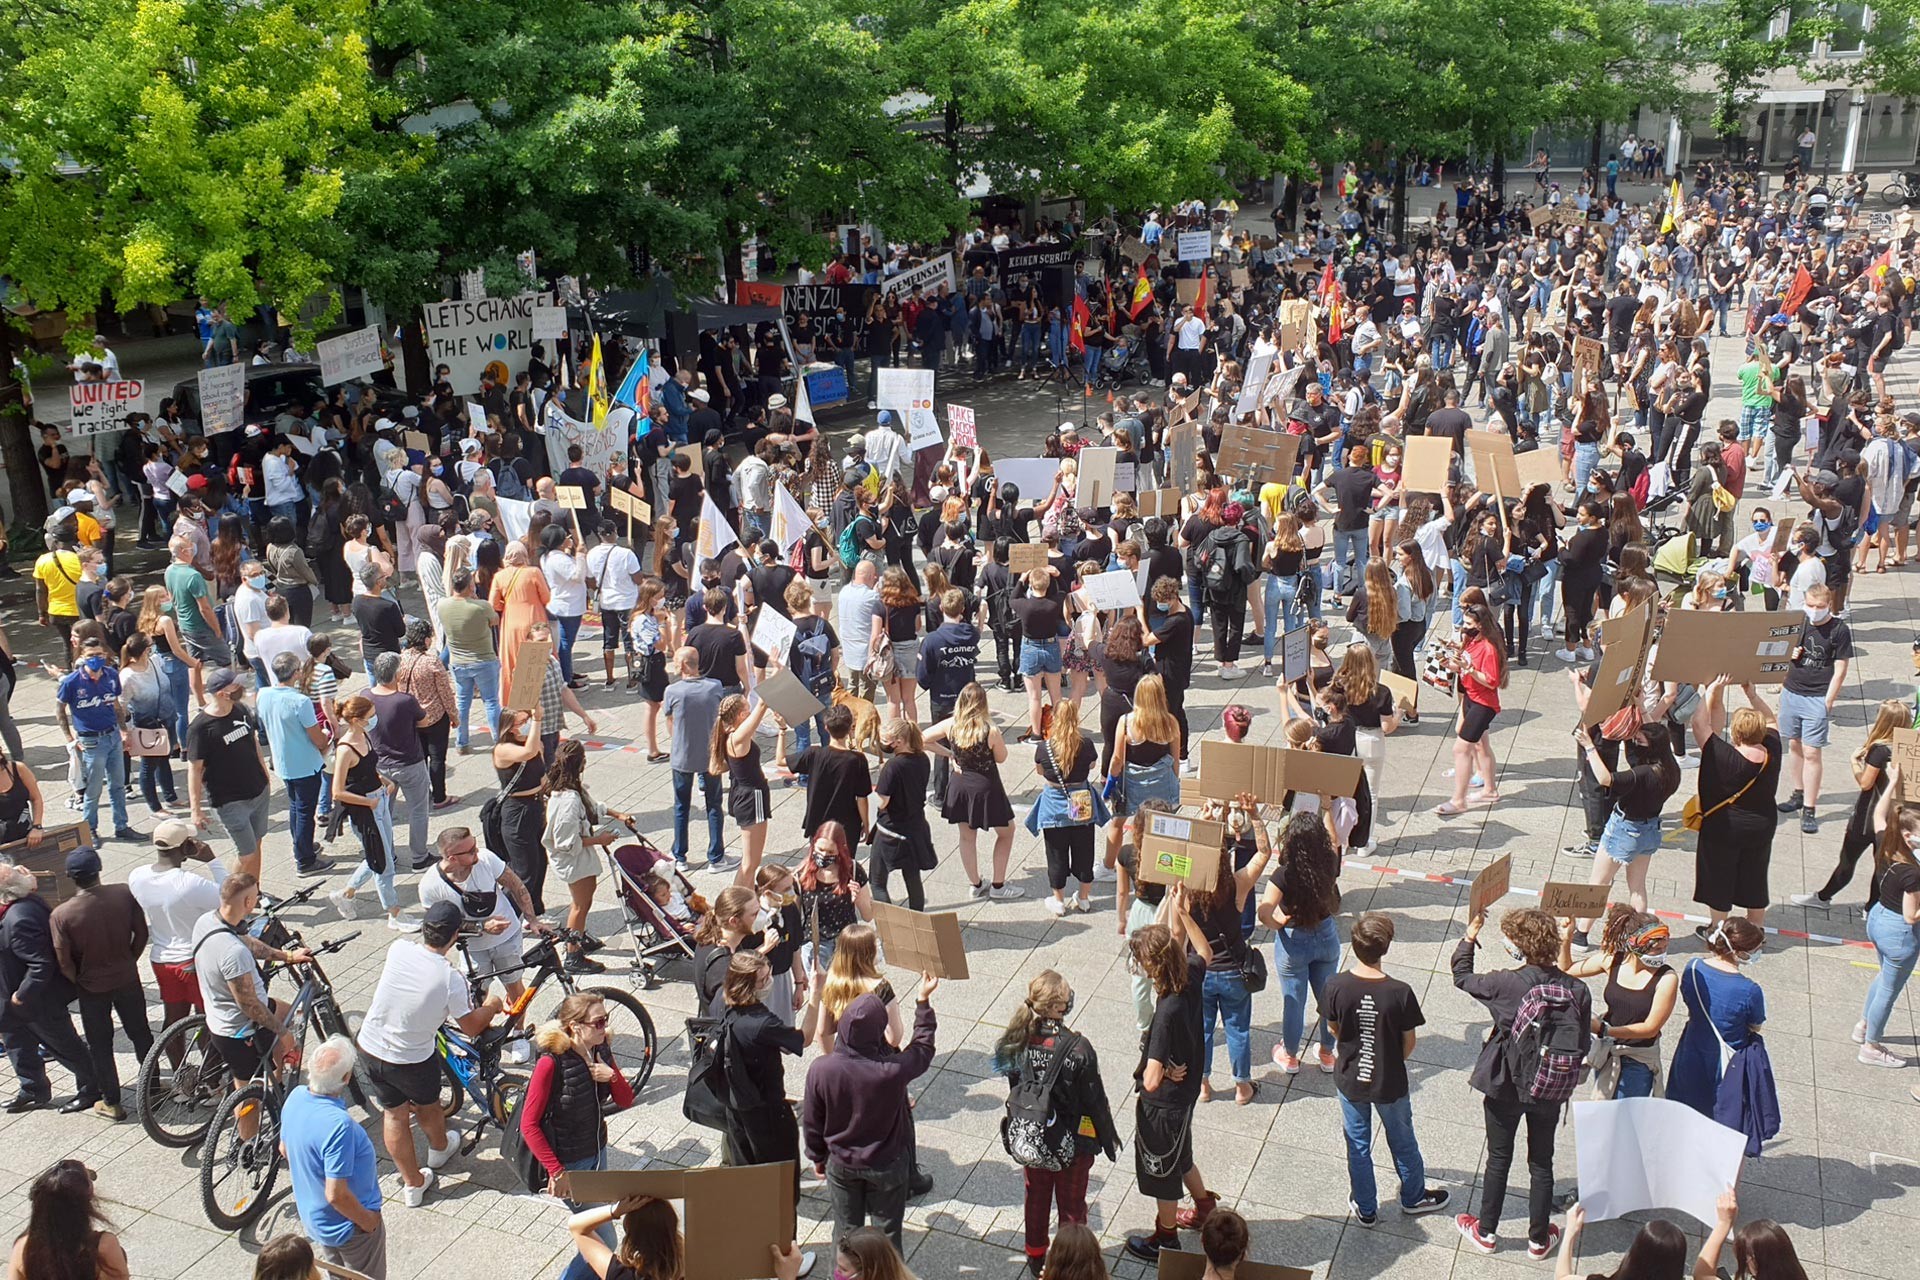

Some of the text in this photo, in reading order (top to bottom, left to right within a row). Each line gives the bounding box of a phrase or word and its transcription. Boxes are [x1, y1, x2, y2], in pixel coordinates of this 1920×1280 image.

[1008, 254, 1039, 269] KEINEN
[889, 260, 947, 293] GEMEINSAM
[819, 286, 840, 311] ZU
[340, 332, 375, 351] Justice
[433, 338, 468, 358] THE
[72, 380, 142, 405] UNITED
[73, 399, 128, 418] we fight
[949, 405, 975, 424] MAKE
[78, 416, 128, 434] racism
[950, 420, 976, 436] RACISM
[940, 645, 975, 655] Teamer
[223, 726, 249, 745] PUMA
